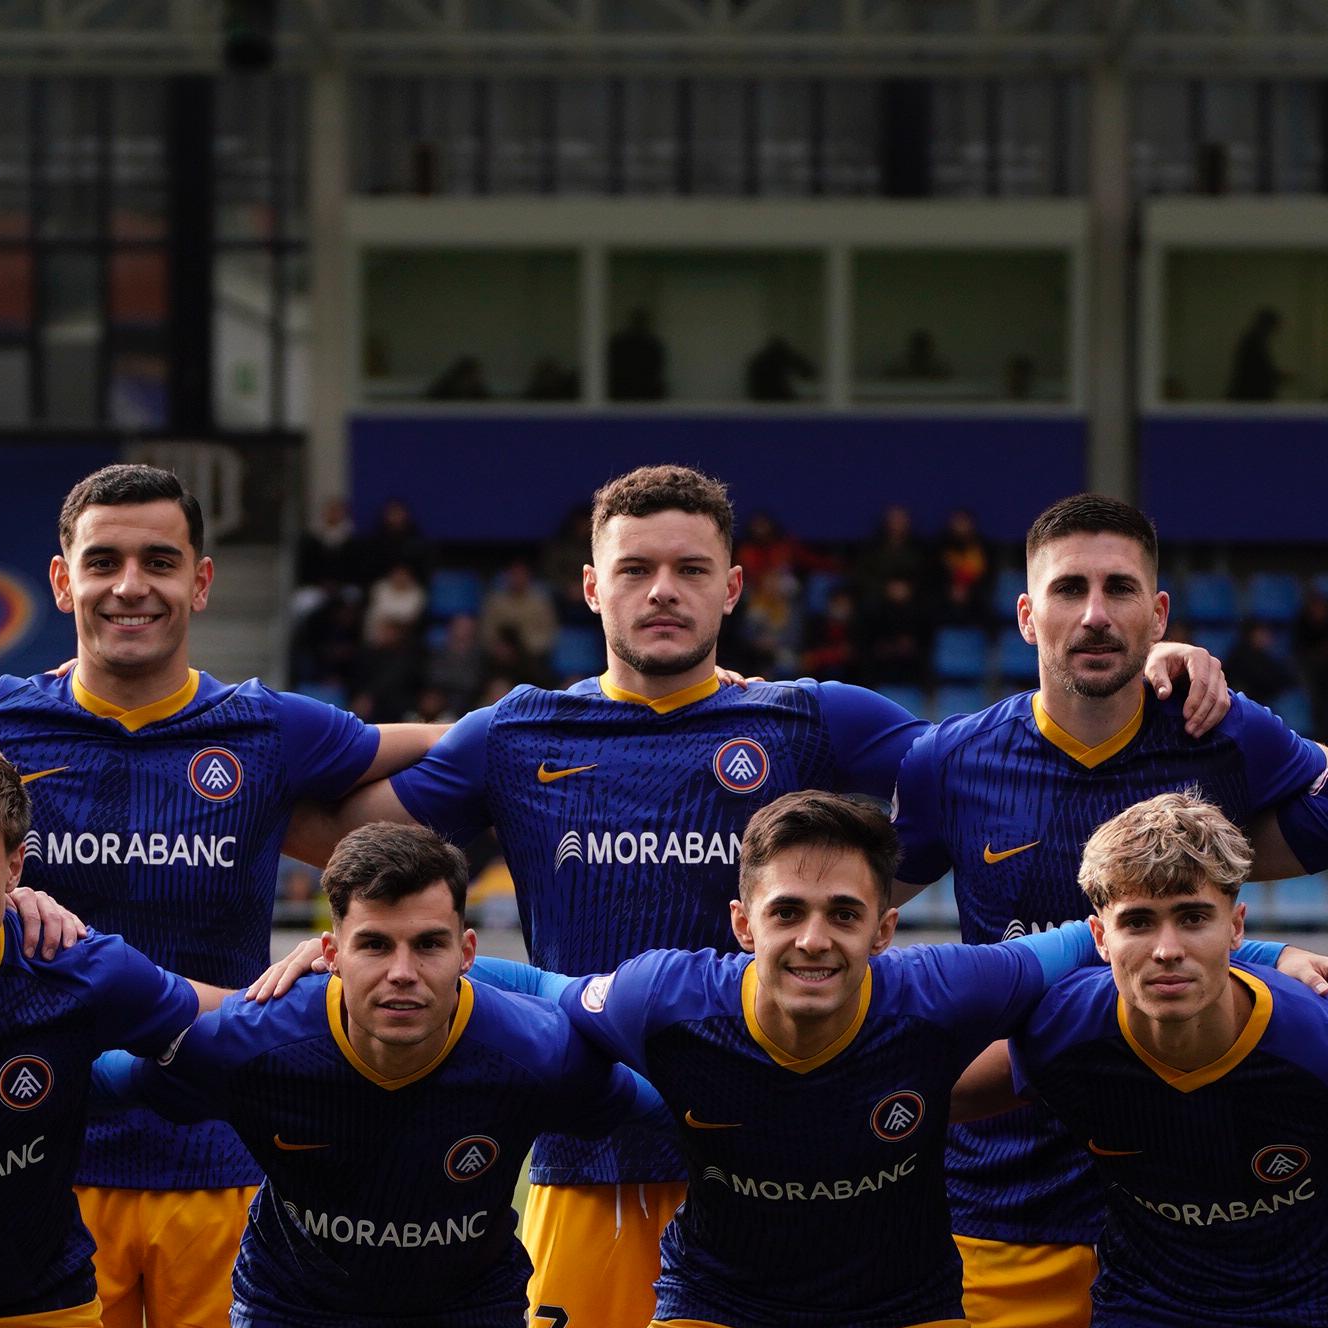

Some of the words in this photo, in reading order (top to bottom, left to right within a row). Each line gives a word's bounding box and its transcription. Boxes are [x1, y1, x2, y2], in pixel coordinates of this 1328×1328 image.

[47, 832, 236, 868] MORABANC
[587, 831, 743, 864] MORABAN
[731, 1153, 918, 1201] MORABANC
[304, 1209, 488, 1248] MORABANC
